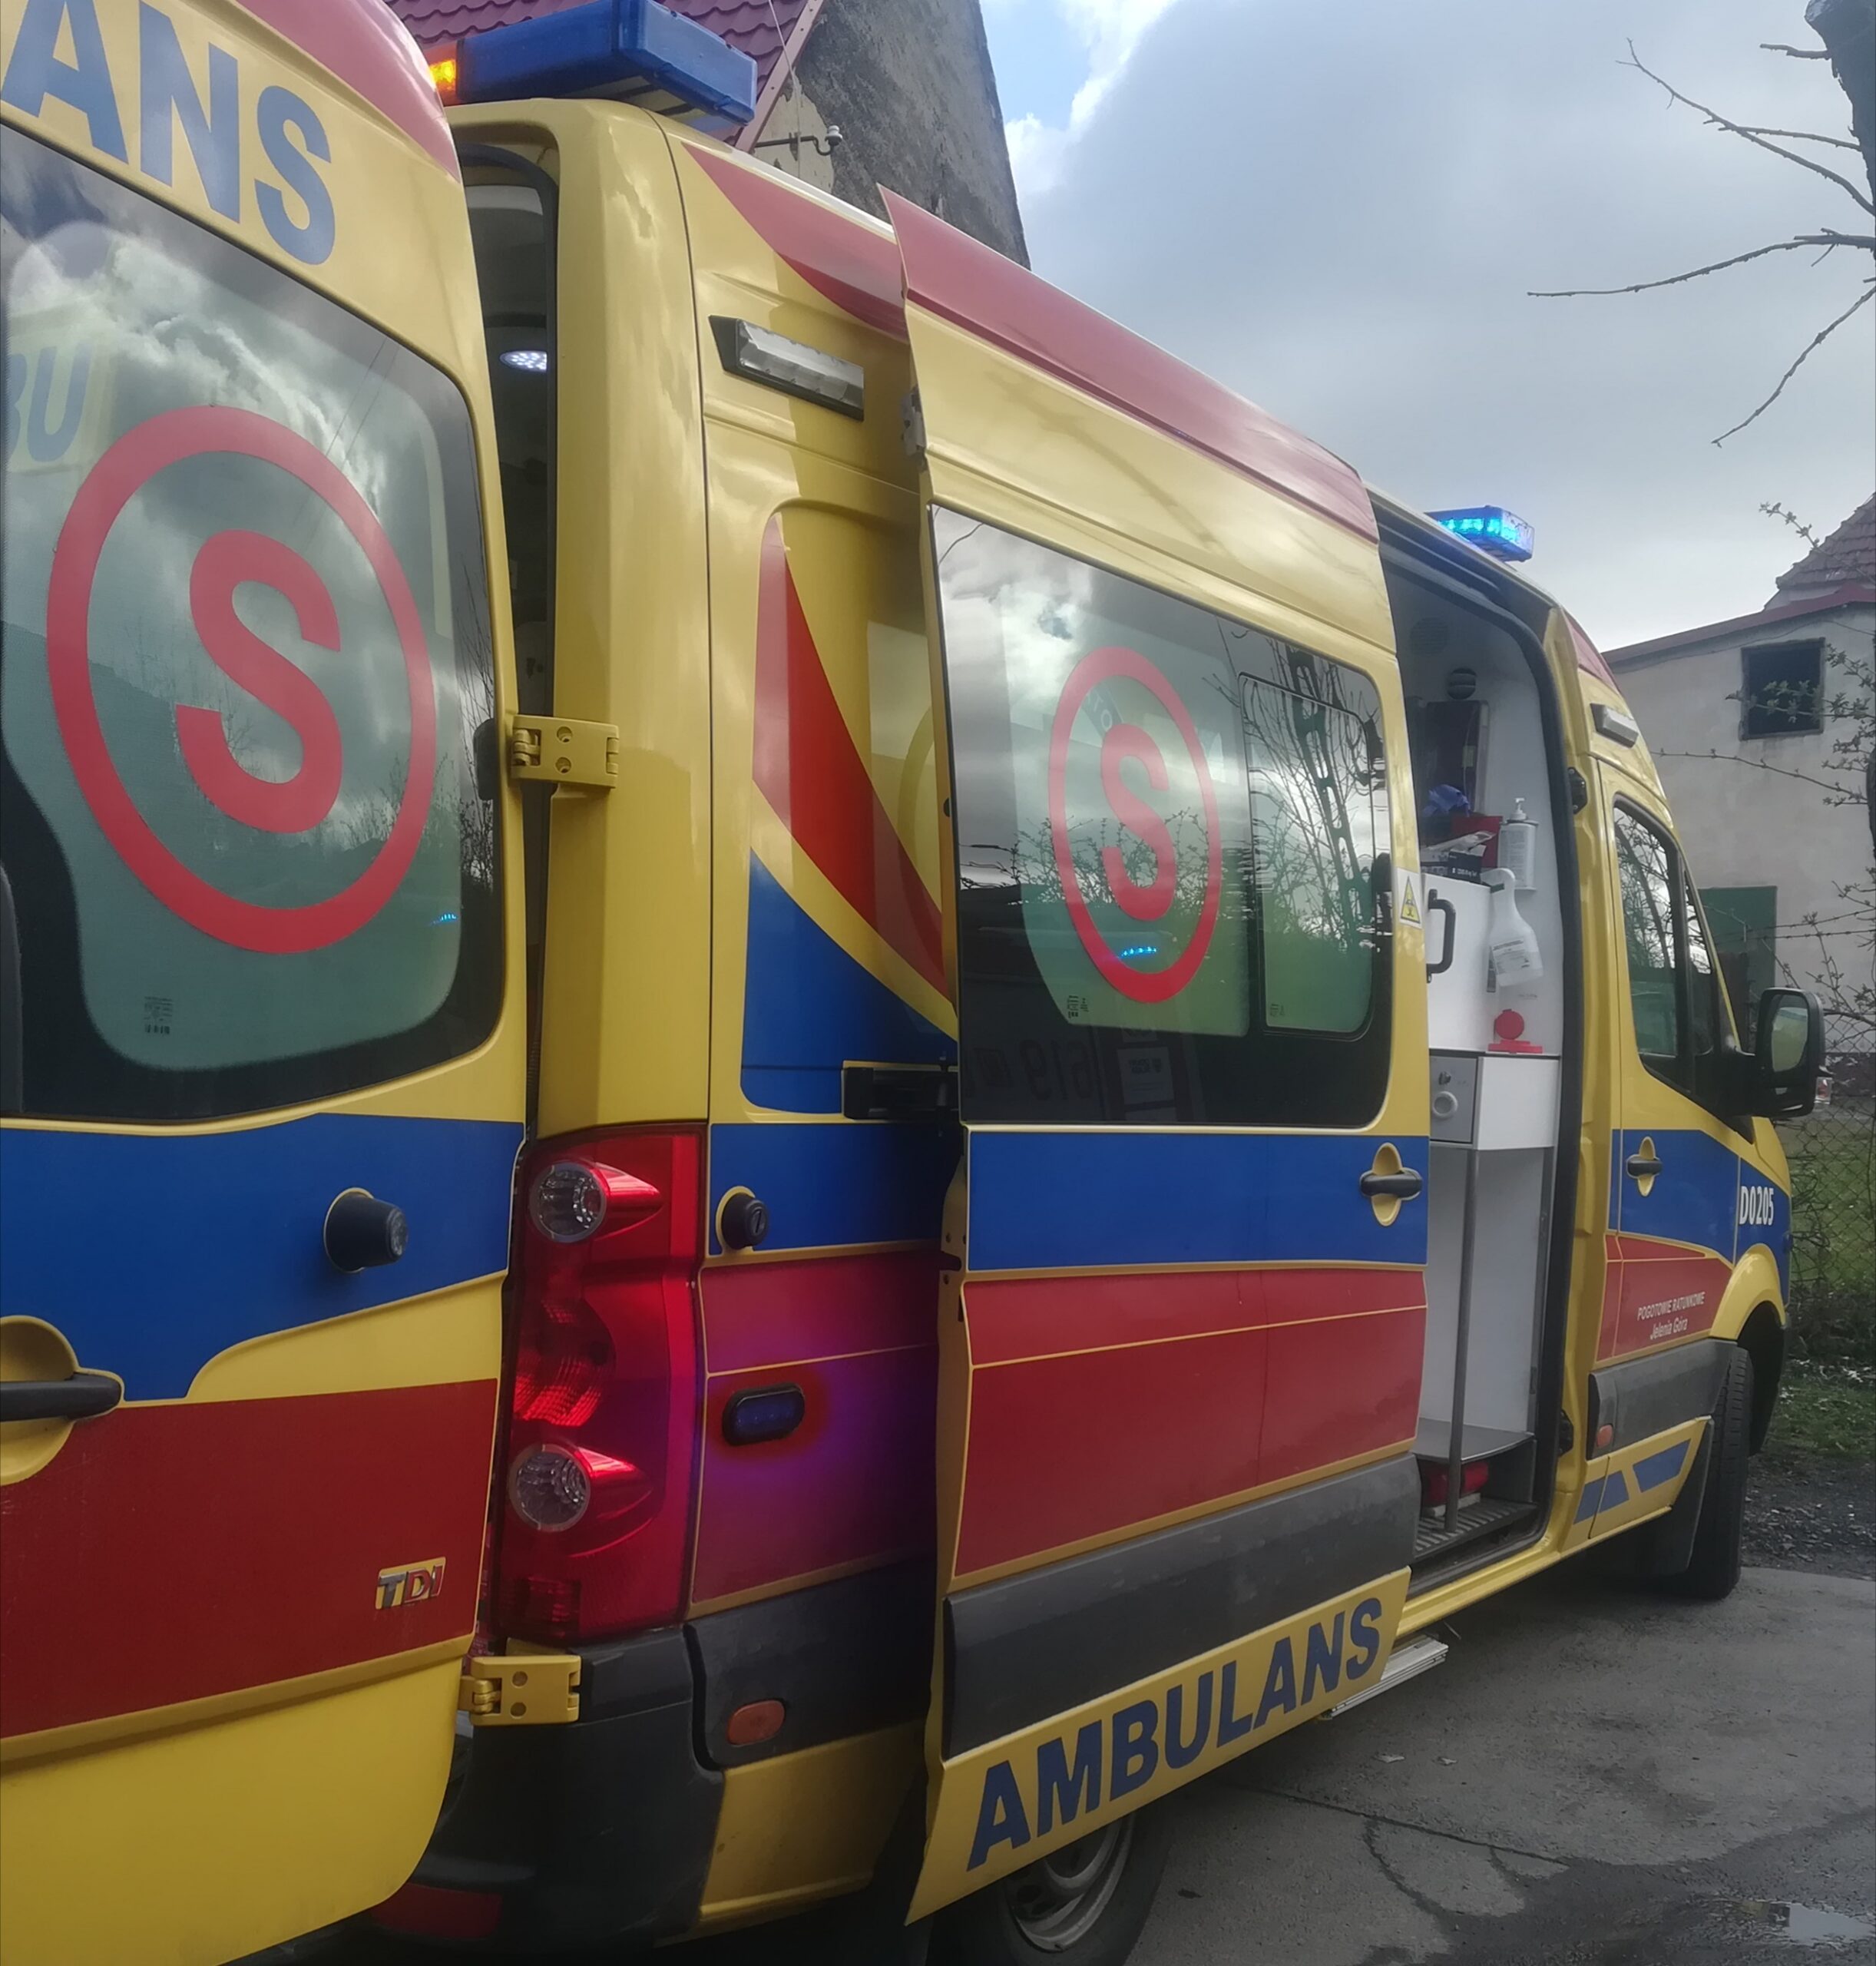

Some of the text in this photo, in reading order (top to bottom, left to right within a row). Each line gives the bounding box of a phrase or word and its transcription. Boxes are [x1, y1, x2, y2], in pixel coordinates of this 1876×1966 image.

[0, 0, 336, 266] ANS
[176, 528, 342, 833] S
[1101, 724, 1176, 922] S
[1637, 1299, 1673, 1321] POGOTOWIE
[378, 1564, 444, 1609] TDI
[967, 1597, 1383, 1872] AMBULANS
